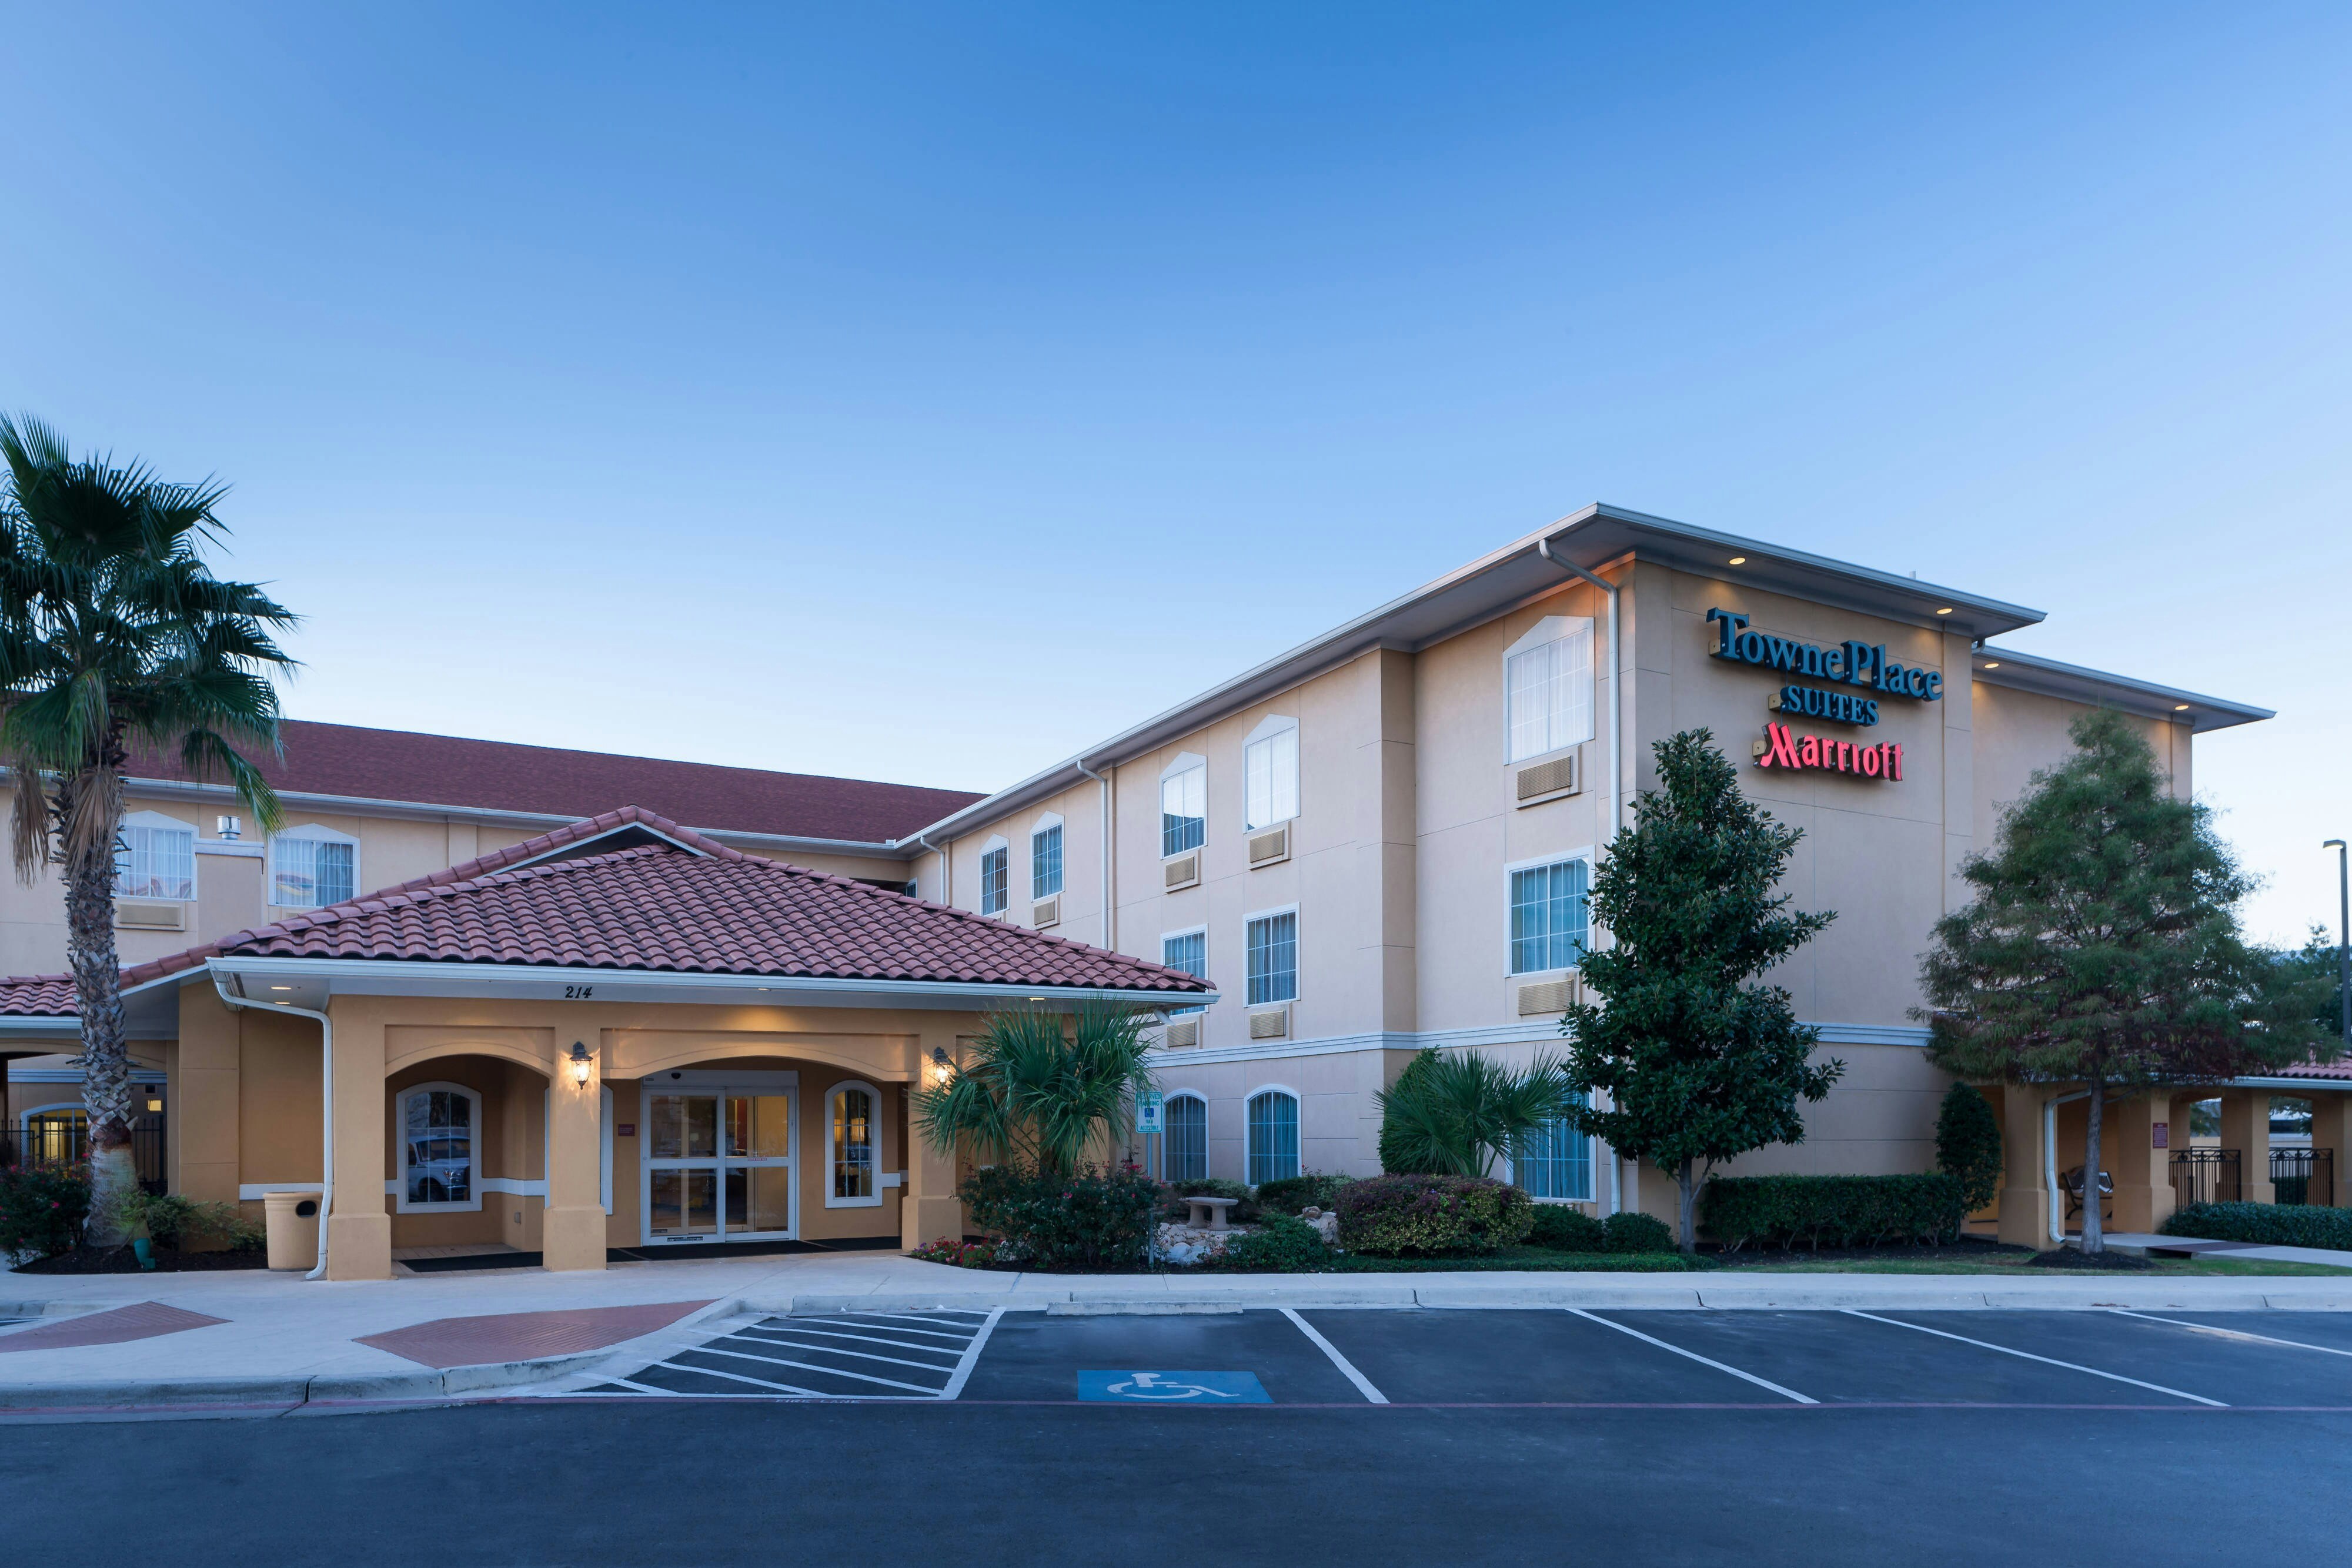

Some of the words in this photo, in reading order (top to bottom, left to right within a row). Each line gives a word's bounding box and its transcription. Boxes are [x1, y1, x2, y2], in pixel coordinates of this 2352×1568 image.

[1706, 607, 1943, 701] TownePlace
[1780, 684, 1880, 727] SUITES
[1759, 721, 1905, 782] Marriott
[565, 985, 593, 998] 214
